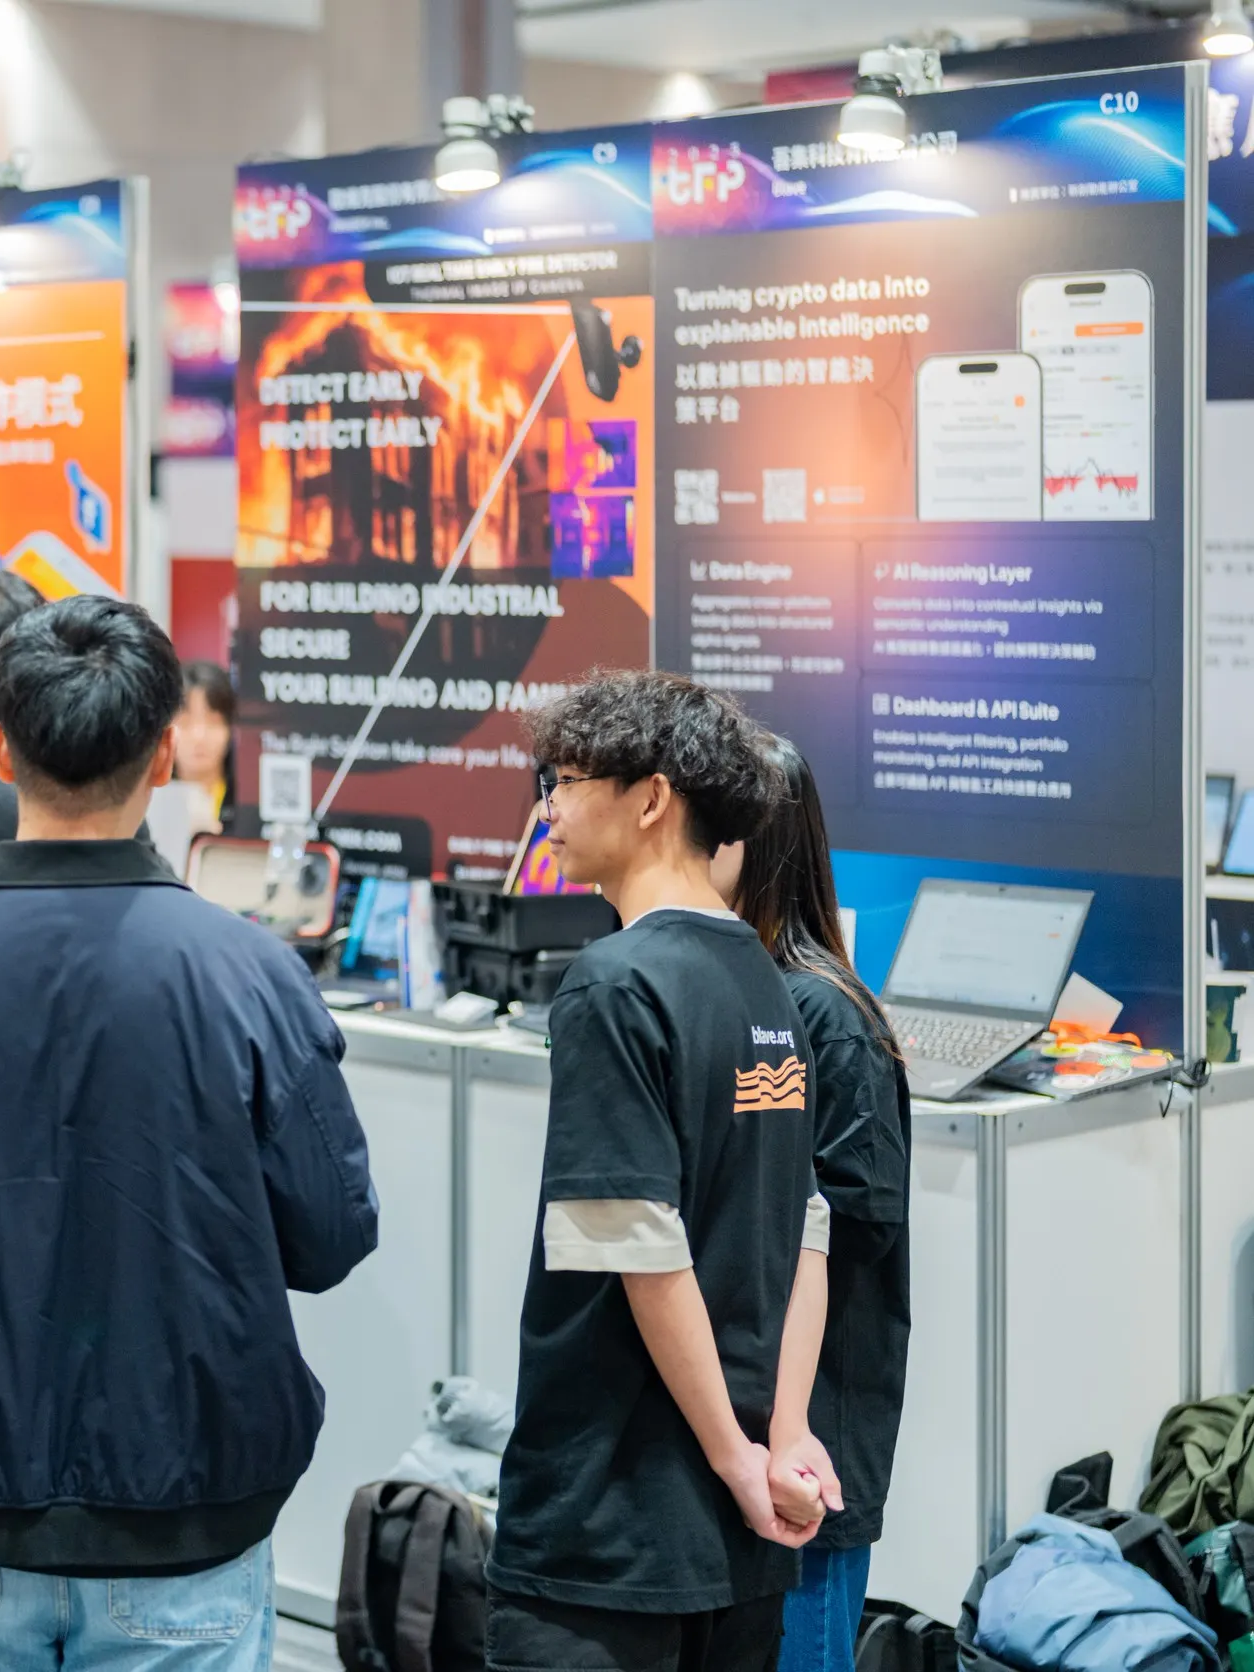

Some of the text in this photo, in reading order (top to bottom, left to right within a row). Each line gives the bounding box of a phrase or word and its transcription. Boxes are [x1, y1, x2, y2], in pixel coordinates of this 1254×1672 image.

[1099, 91, 1139, 115] C10
[674, 274, 930, 313] Turning crypto data into
[674, 312, 930, 350] explainable intelligence
[259, 370, 423, 405] DETECT EARLY
[259, 416, 442, 450] PROTECT EARLY
[910, 562, 988, 585] Reasoning
[989, 563, 1033, 586] Layer
[260, 581, 564, 617] FOR BUILDING INDUSTRIAL
[1084, 599, 1103, 615] via
[260, 627, 350, 660] SECURE
[260, 672, 328, 704] YOUR
[328, 674, 438, 709] BUILDING
[439, 678, 494, 711] AND
[893, 695, 1060, 722] Dashboard & API Suite
[391, 739, 427, 763] take
[427, 744, 465, 766] care
[465, 746, 500, 771] your
[751, 1026, 795, 1049] blave.org
